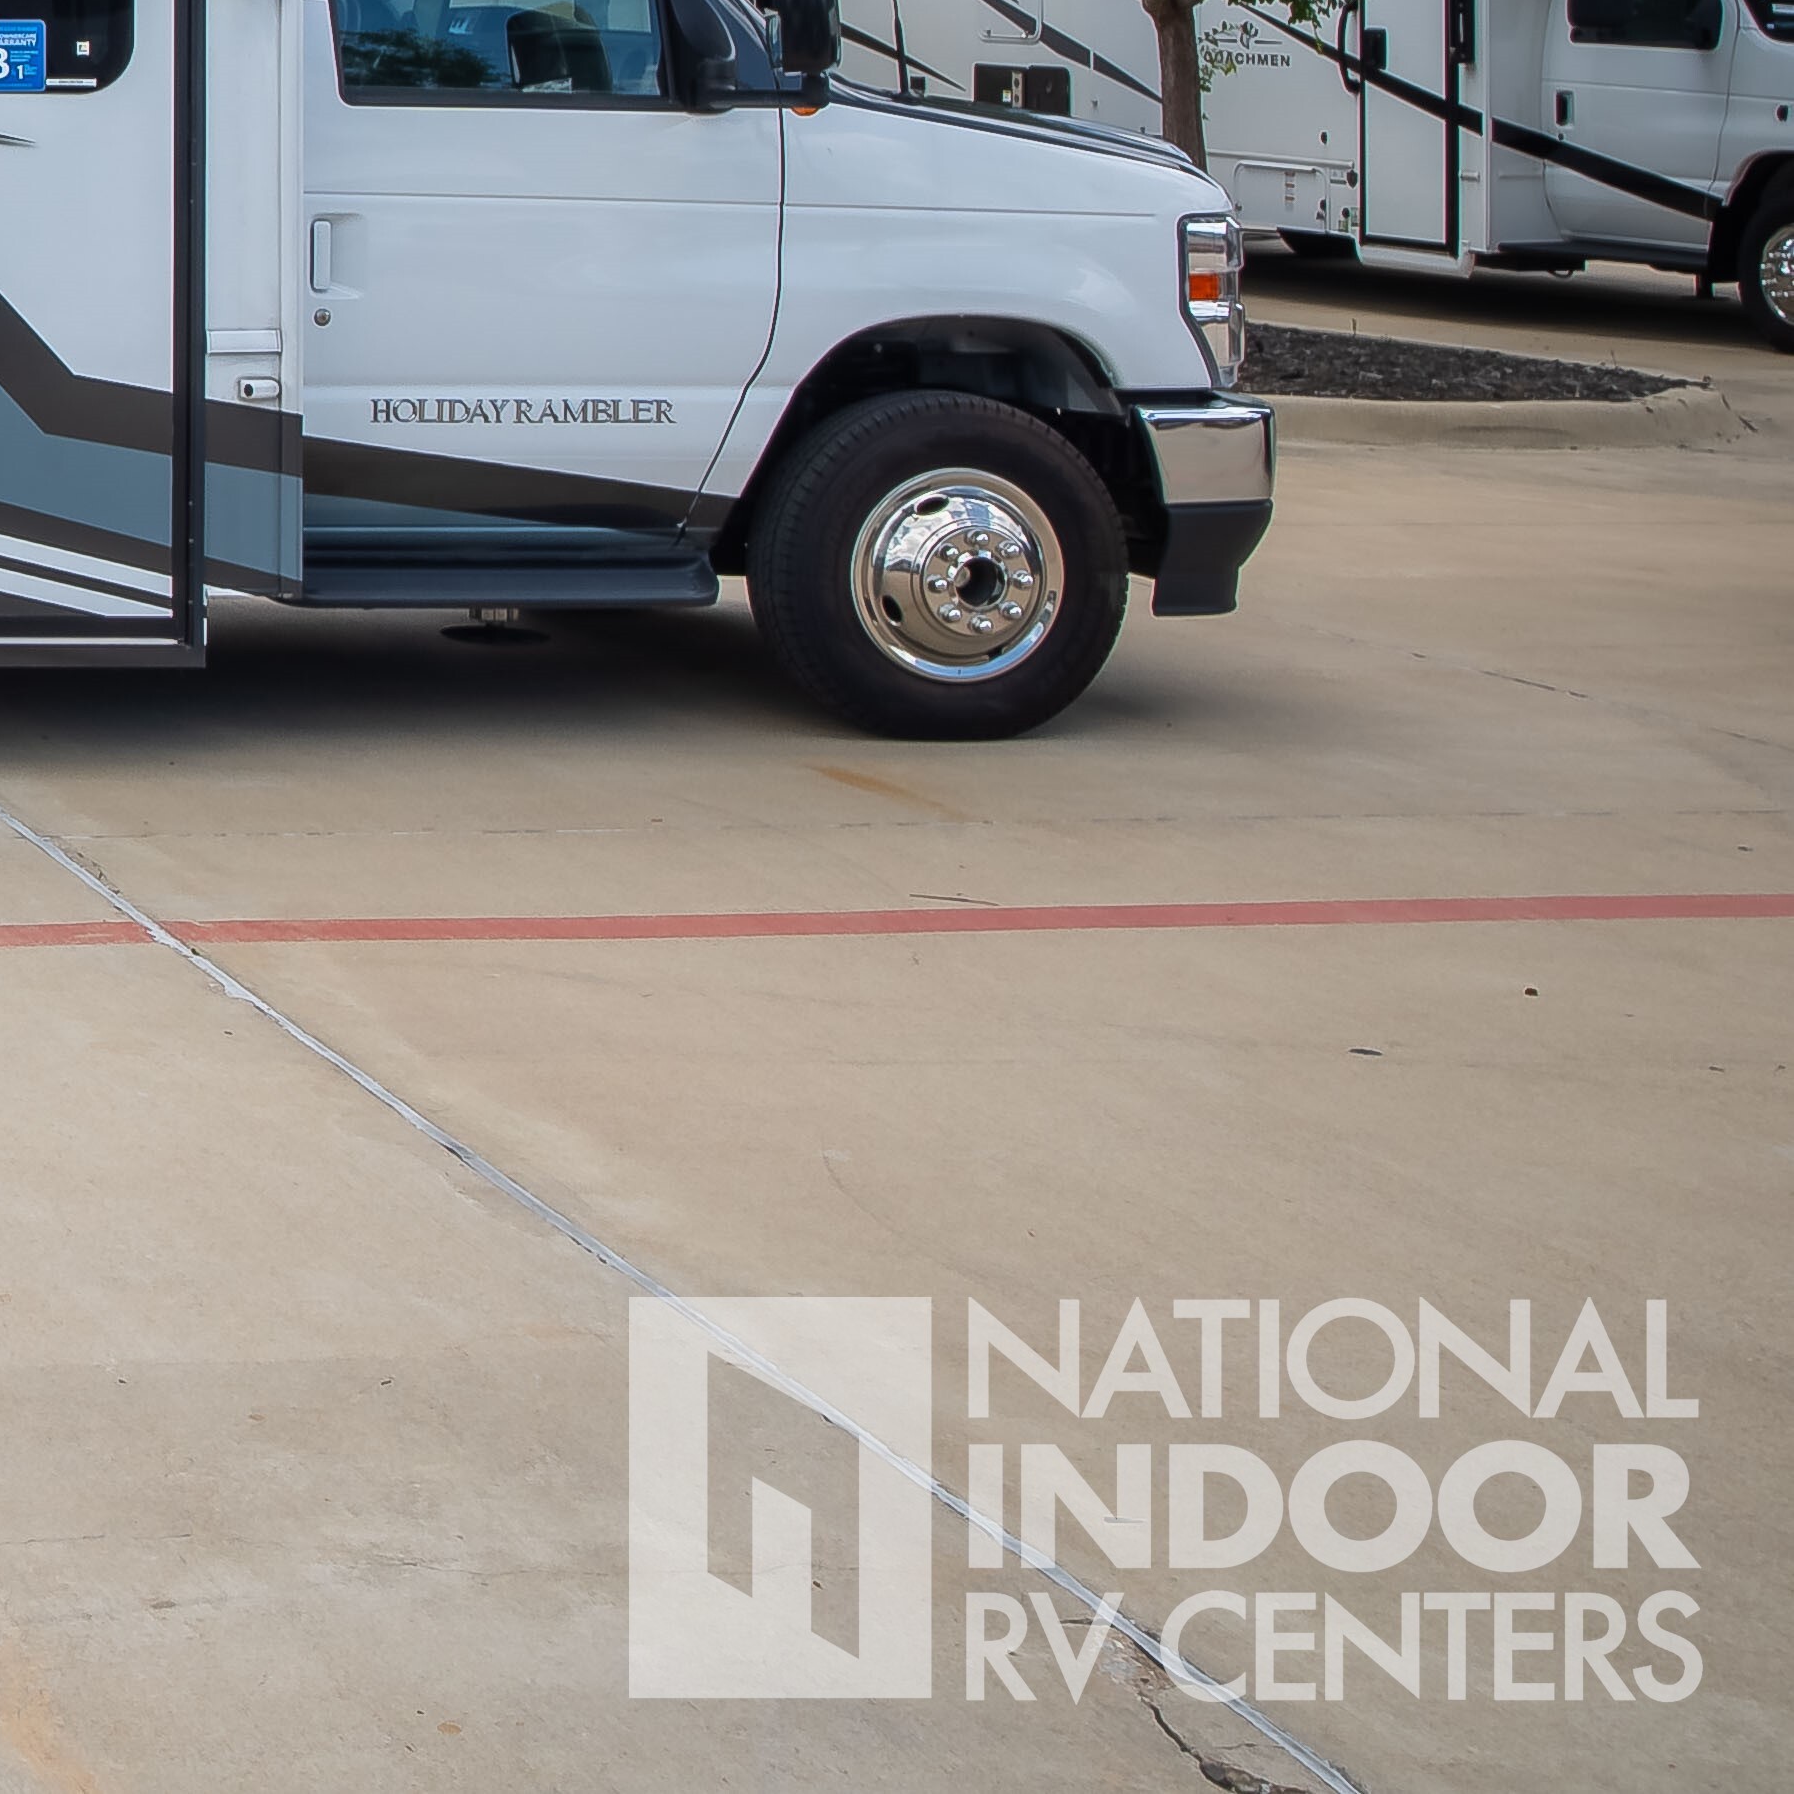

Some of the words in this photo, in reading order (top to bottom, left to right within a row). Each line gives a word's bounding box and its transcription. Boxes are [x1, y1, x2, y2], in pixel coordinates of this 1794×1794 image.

[17, 65, 23, 79] 1
[369, 398, 510, 424] HOLIDAY
[512, 399, 678, 424] RAMBLER
